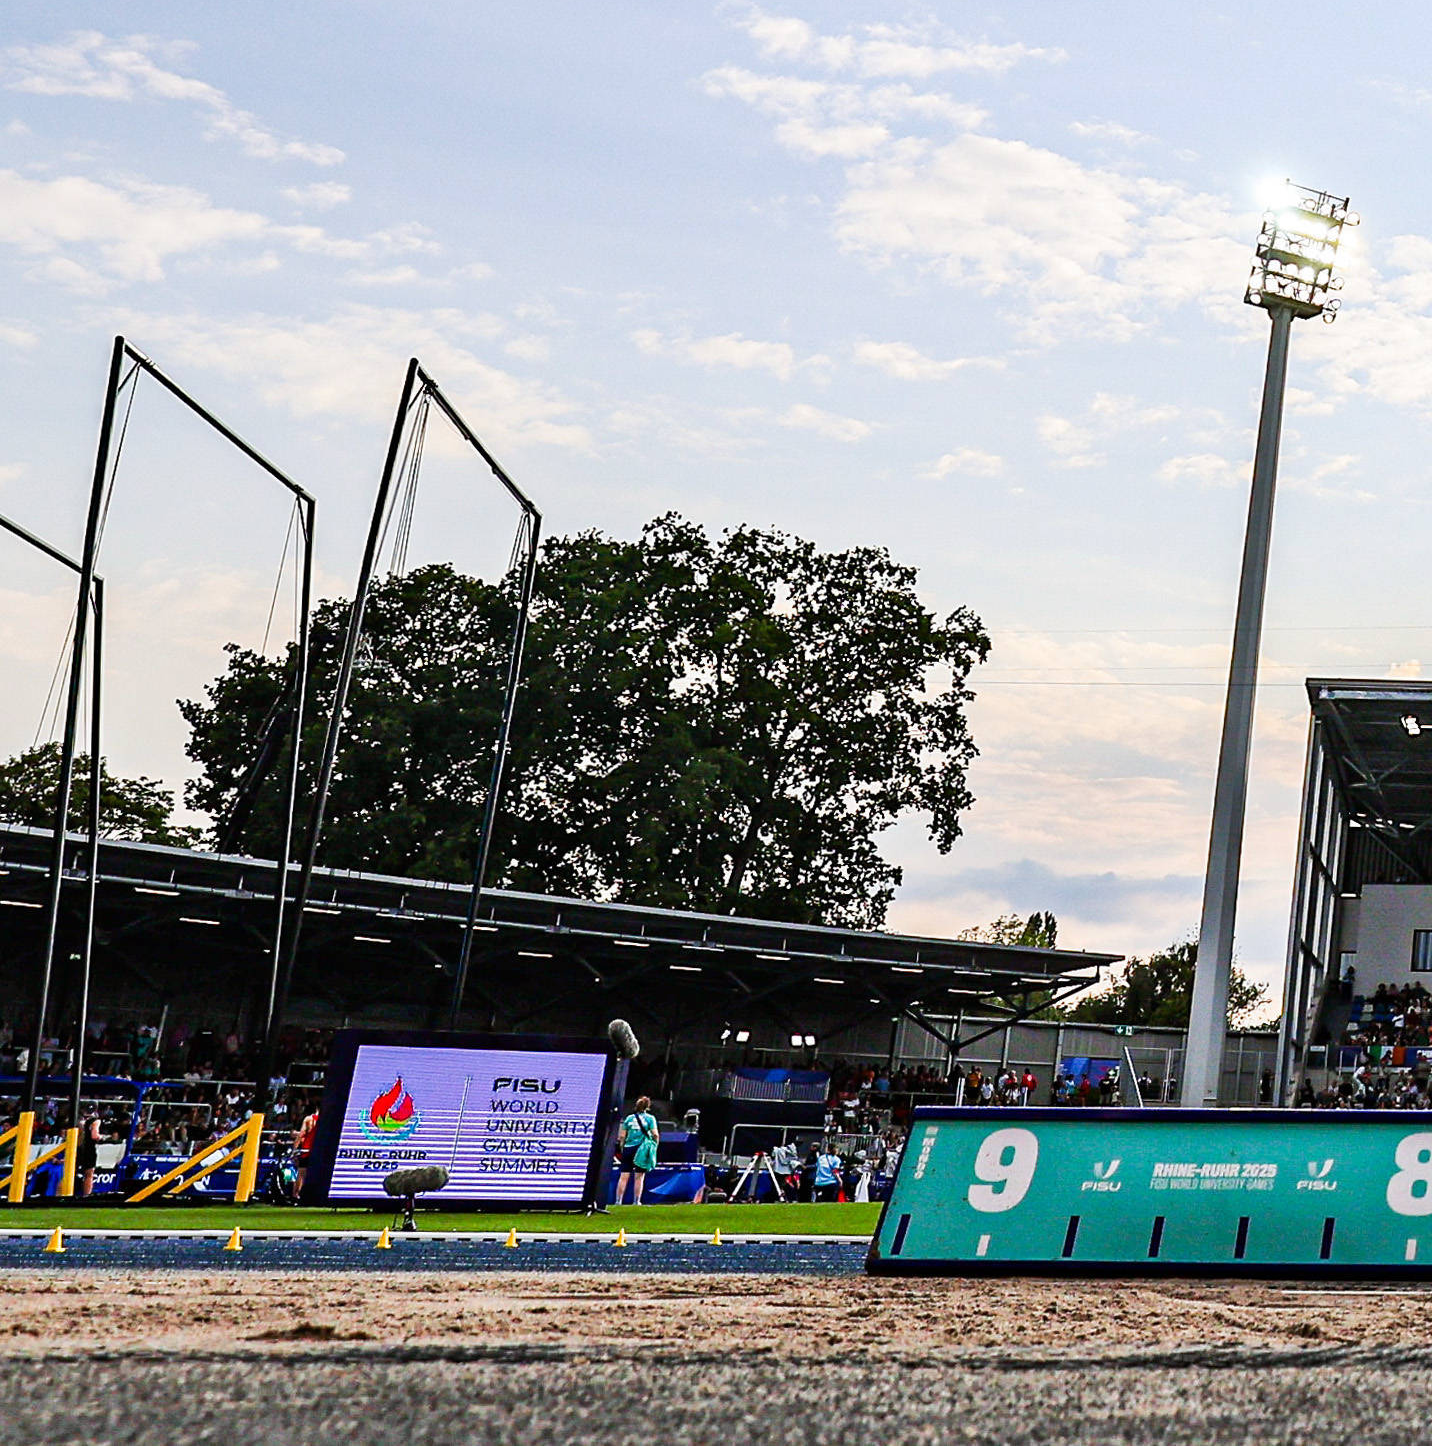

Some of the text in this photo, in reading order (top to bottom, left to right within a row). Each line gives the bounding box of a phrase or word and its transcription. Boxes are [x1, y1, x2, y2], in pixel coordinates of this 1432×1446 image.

[492, 1077, 562, 1094] FISU
[490, 1100, 559, 1114] WORLD
[486, 1120, 593, 1134] UNIVERSITY
[483, 1139, 547, 1153] GAMES
[338, 1149, 428, 1160] RHINE-RUHR
[479, 1159, 558, 1173] SUMMER
[968, 1128, 1039, 1213] 9
[1152, 1162, 1278, 1178] RHINE-RUHR 2025
[1080, 1181, 1122, 1192] FISU
[1296, 1180, 1337, 1191] FISU
